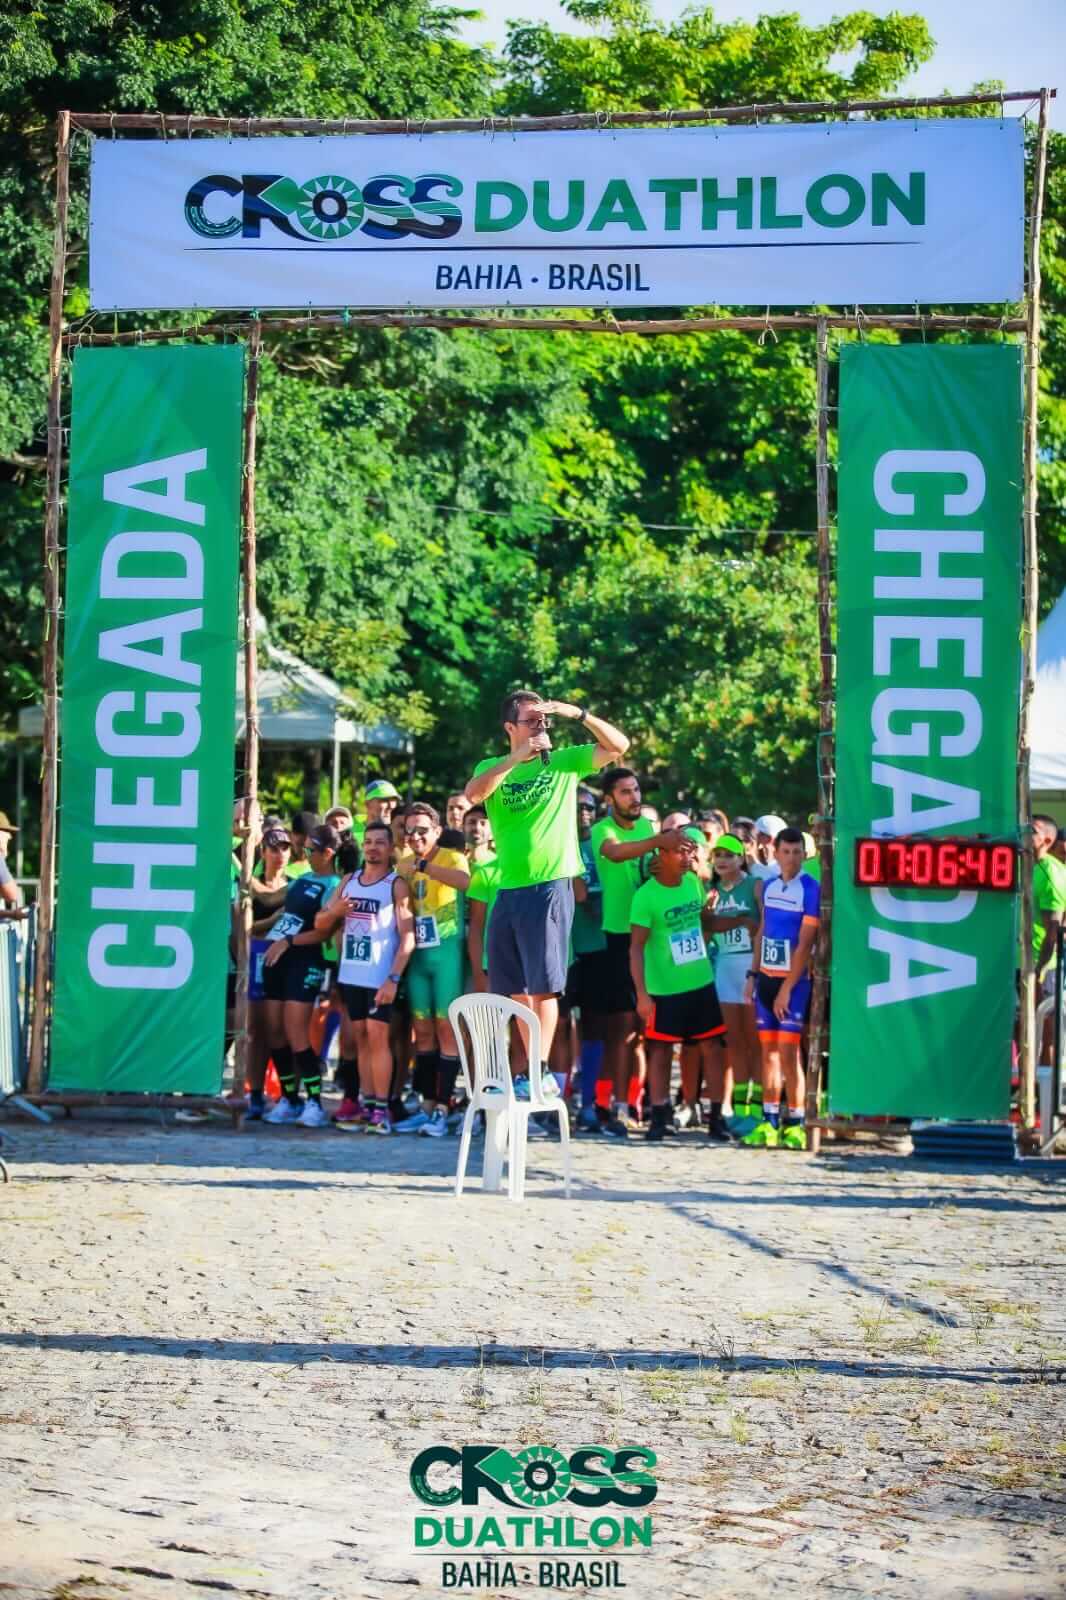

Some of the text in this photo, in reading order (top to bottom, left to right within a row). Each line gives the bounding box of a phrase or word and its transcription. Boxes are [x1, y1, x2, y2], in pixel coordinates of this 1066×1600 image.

[184, 172, 925, 242] CROSS DUATHLON
[435, 263, 650, 292] BAHIA BRASIL
[88, 448, 207, 989] CHEGADA
[859, 841, 1013, 887] 07:06:48
[352, 942, 366, 957] 16
[679, 938, 698, 956] 133
